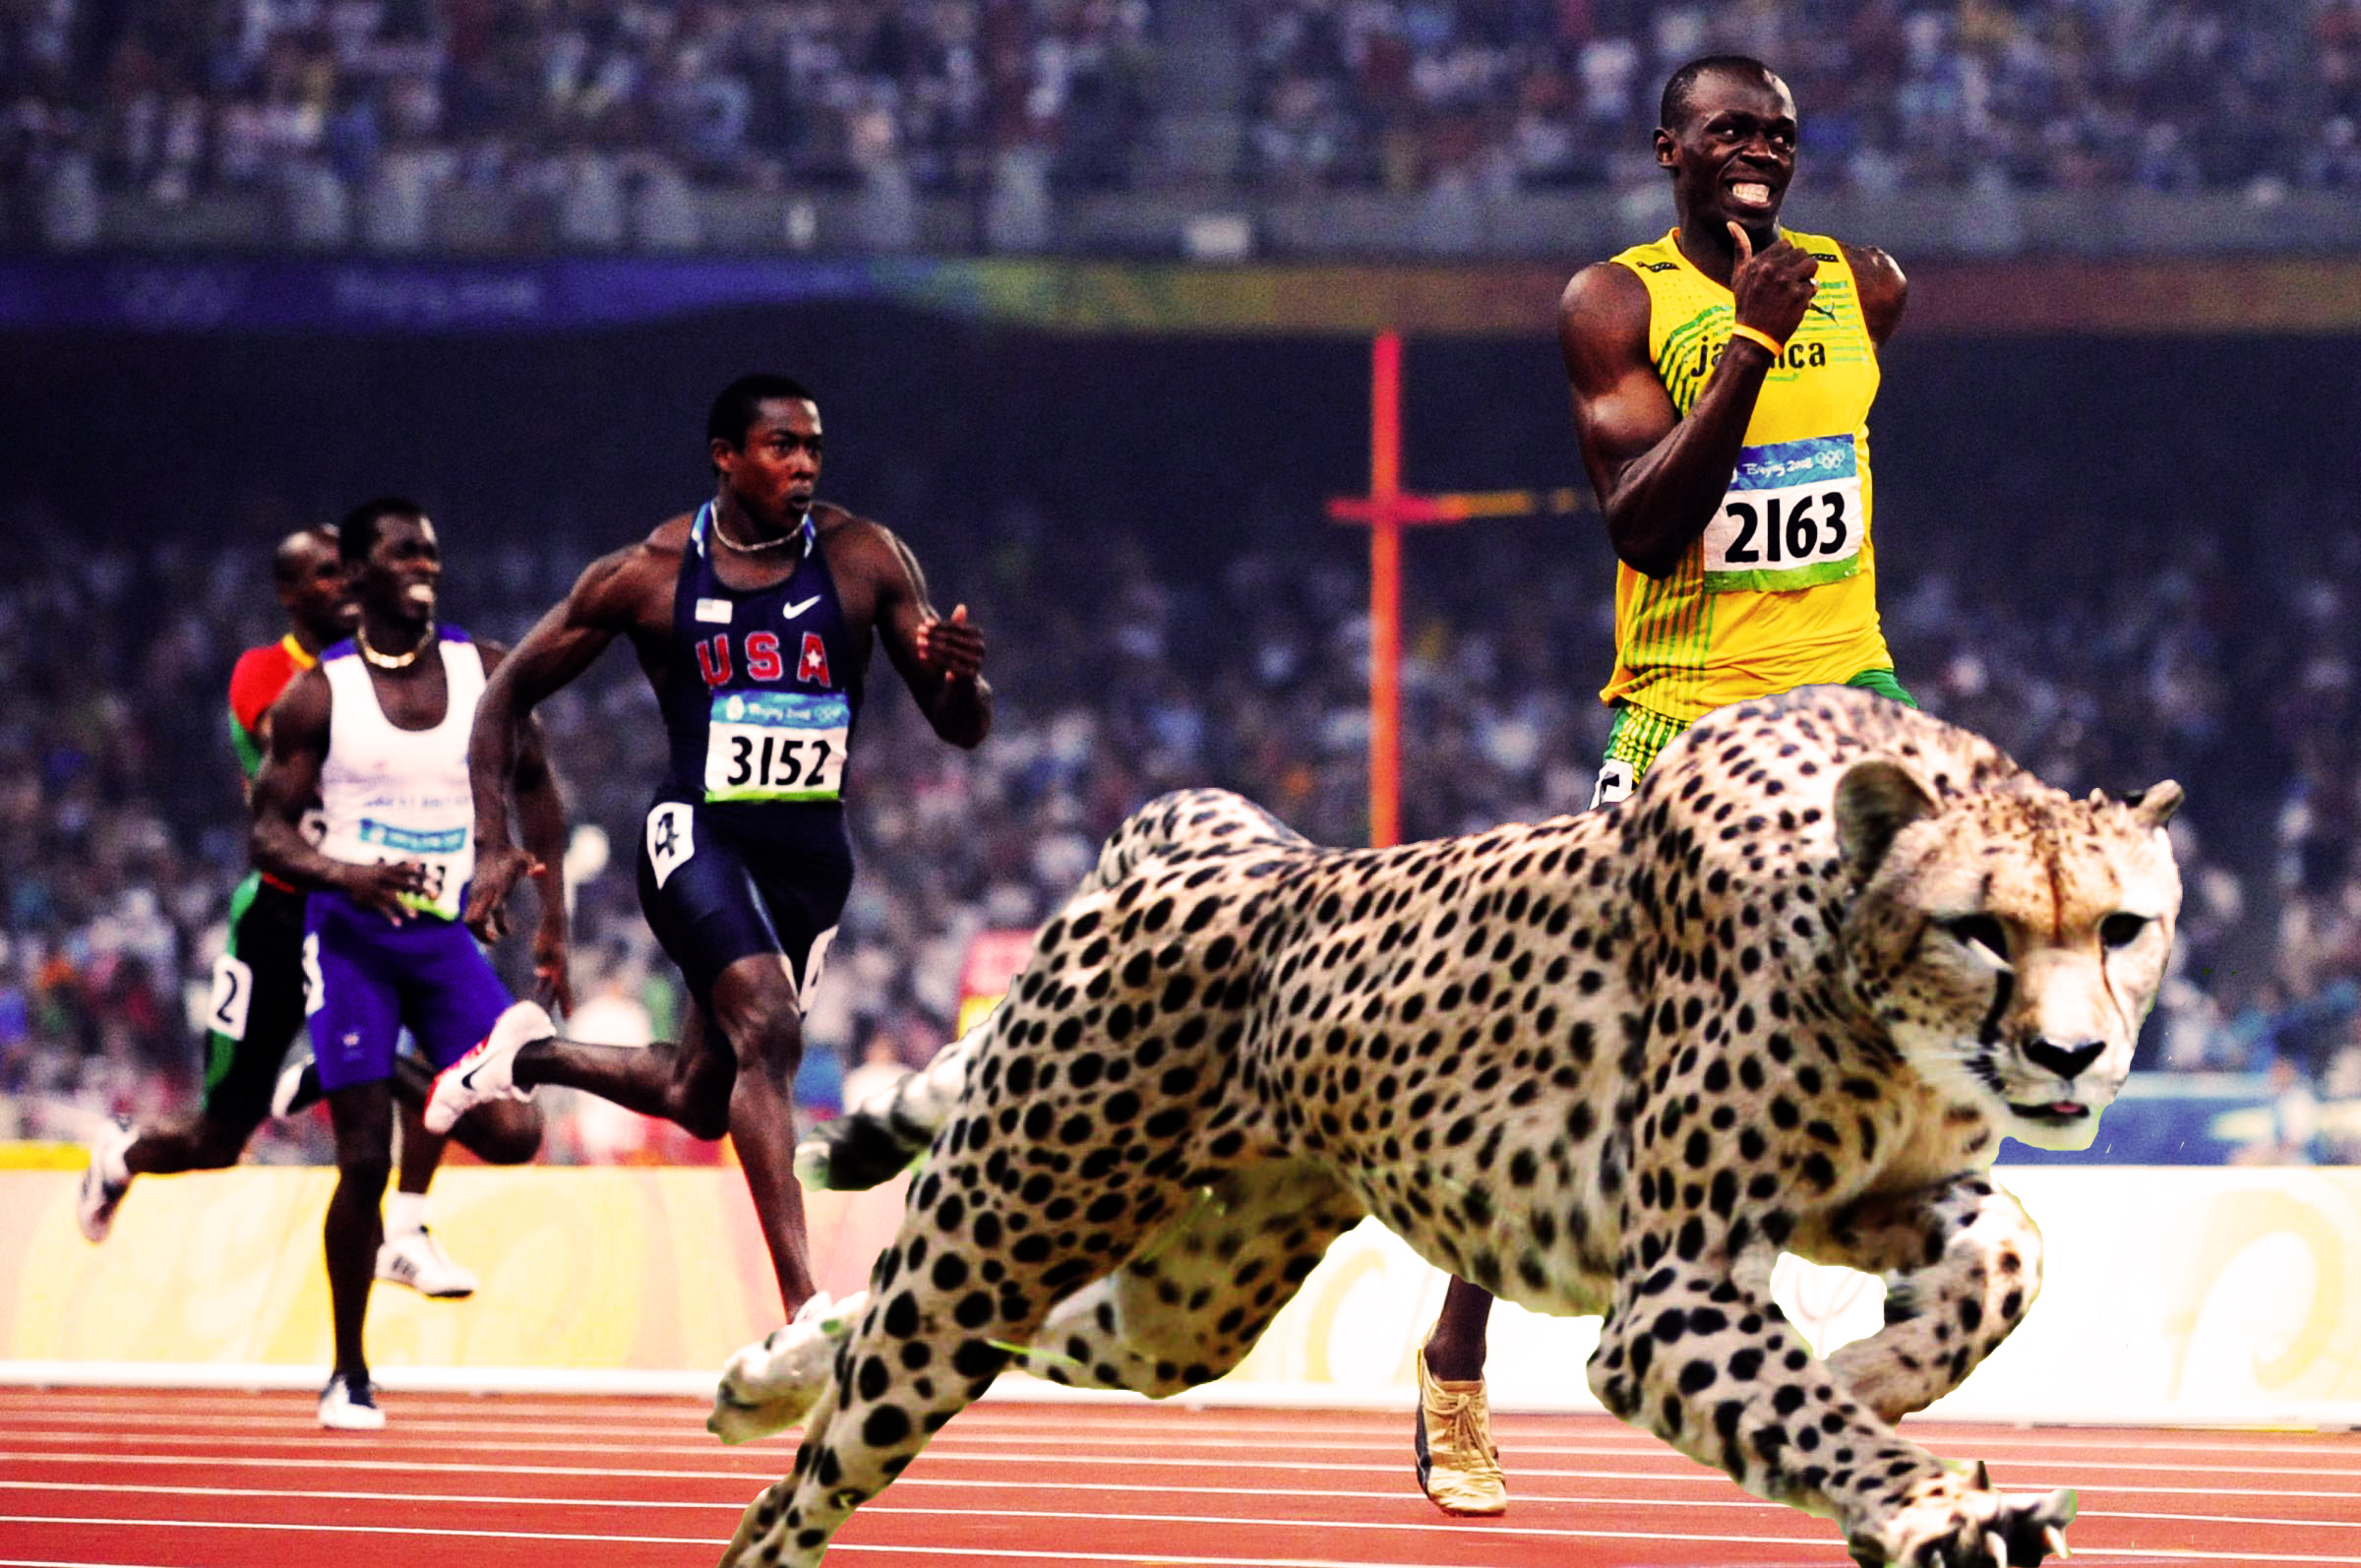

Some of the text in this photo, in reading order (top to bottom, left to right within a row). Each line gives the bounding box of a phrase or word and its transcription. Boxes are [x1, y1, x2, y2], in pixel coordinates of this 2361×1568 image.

[1691, 335, 1826, 377] jaica
[1725, 491, 1847, 564] 2163
[696, 631, 831, 688] USA
[727, 736, 831, 787] 3152
[216, 970, 237, 1023] 2
